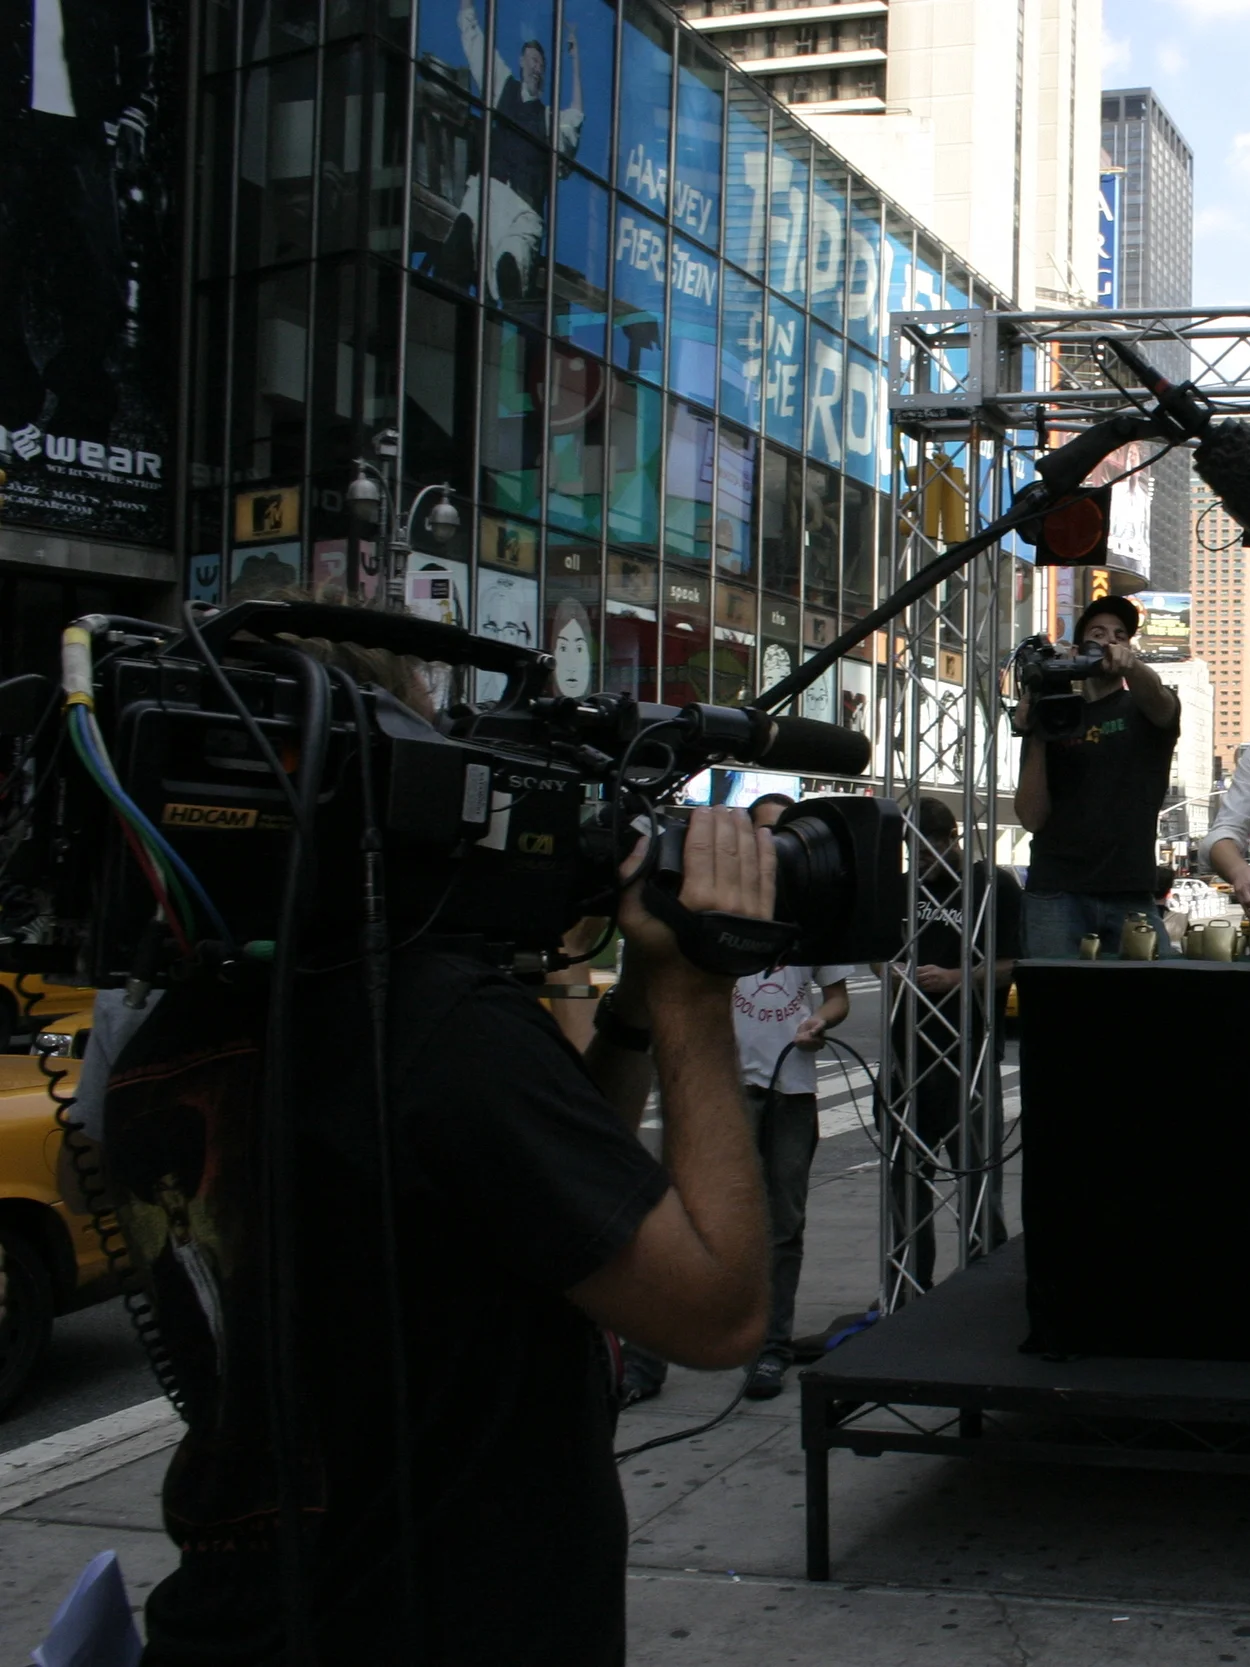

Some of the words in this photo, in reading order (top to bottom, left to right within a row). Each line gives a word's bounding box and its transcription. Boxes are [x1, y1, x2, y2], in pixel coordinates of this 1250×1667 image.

[625, 143, 713, 236] HARVEY
[743, 358, 800, 417] THE
[46, 433, 162, 479] wear
[563, 553, 581, 572] all
[669, 584, 701, 604] speak
[771, 610, 786, 627] the
[508, 774, 568, 792] SONY
[171, 806, 251, 826] HDCAM
[758, 1008, 774, 1023] OF
